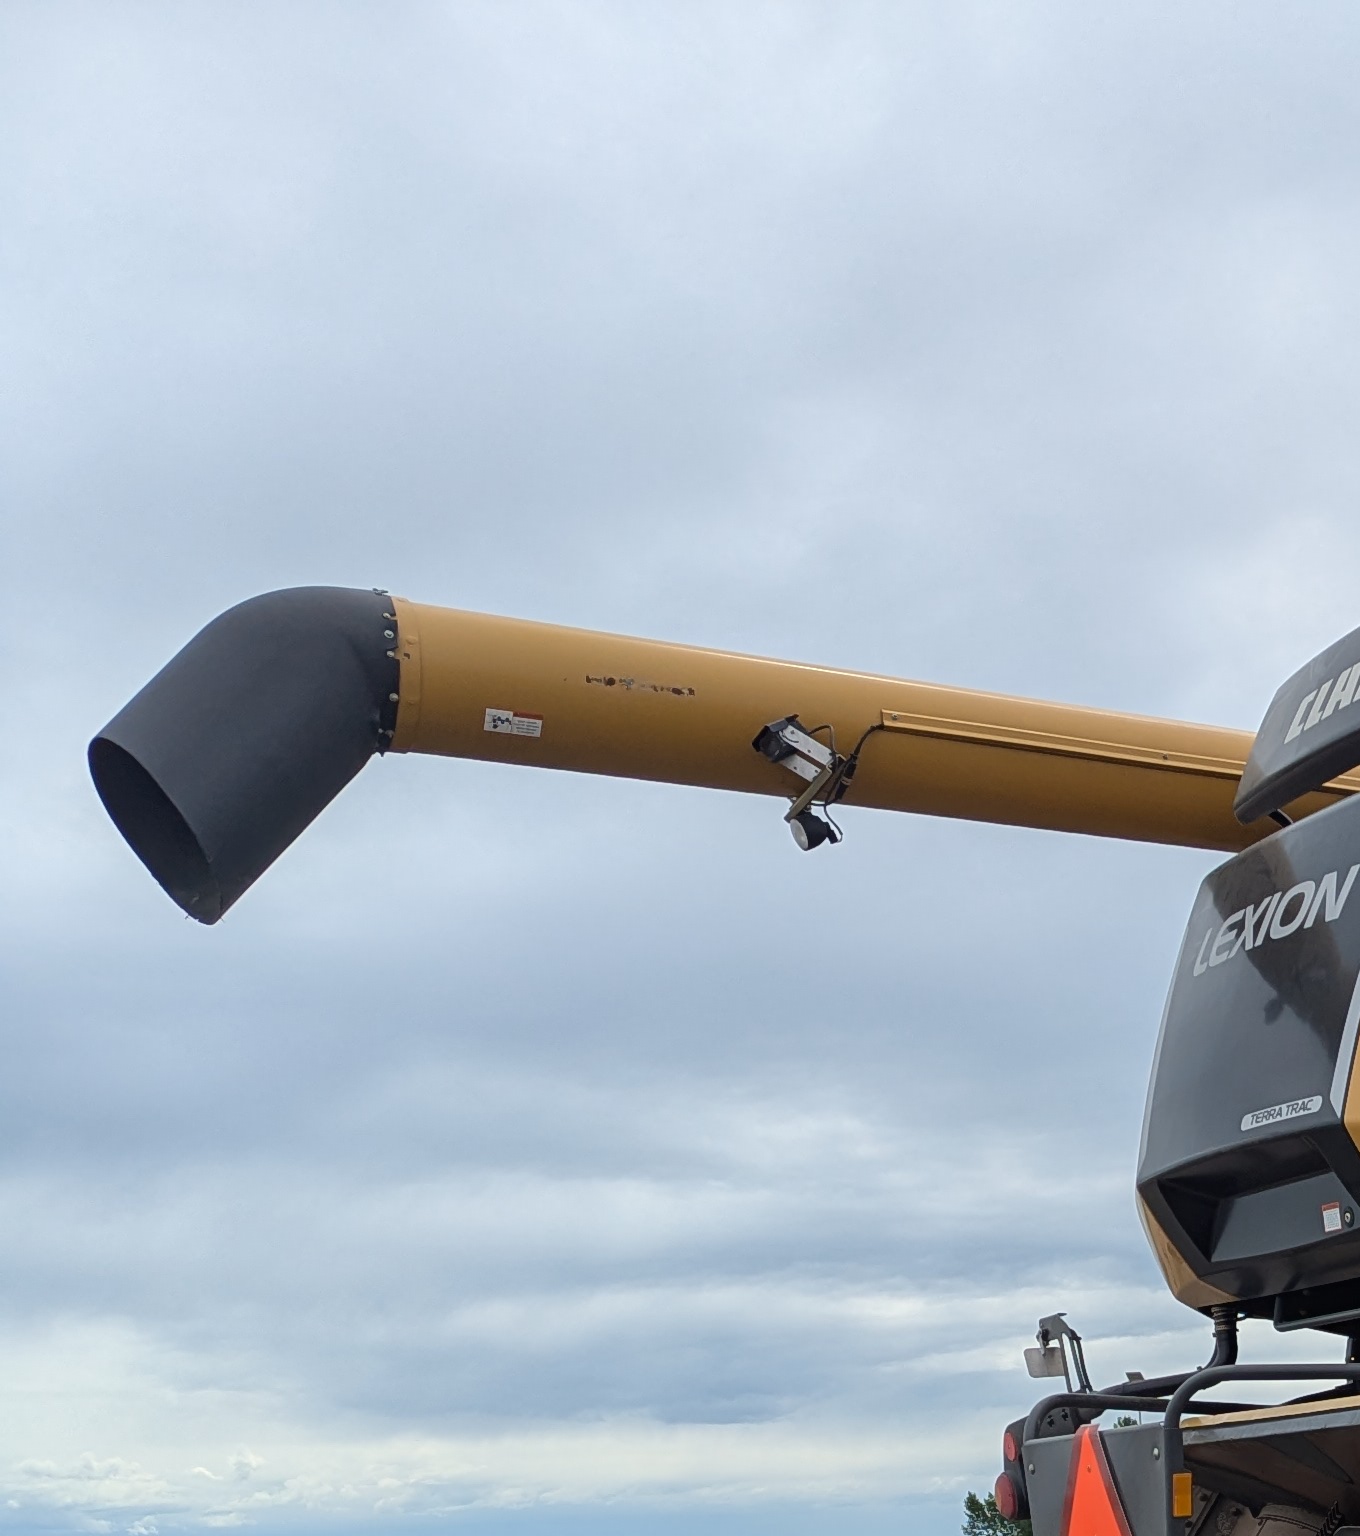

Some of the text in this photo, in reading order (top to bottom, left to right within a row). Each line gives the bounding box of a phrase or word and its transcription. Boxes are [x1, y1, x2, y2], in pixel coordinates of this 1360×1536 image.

[1193, 863, 1360, 977] LEXION
[1250, 1098, 1314, 1126] TERRA TRAC
